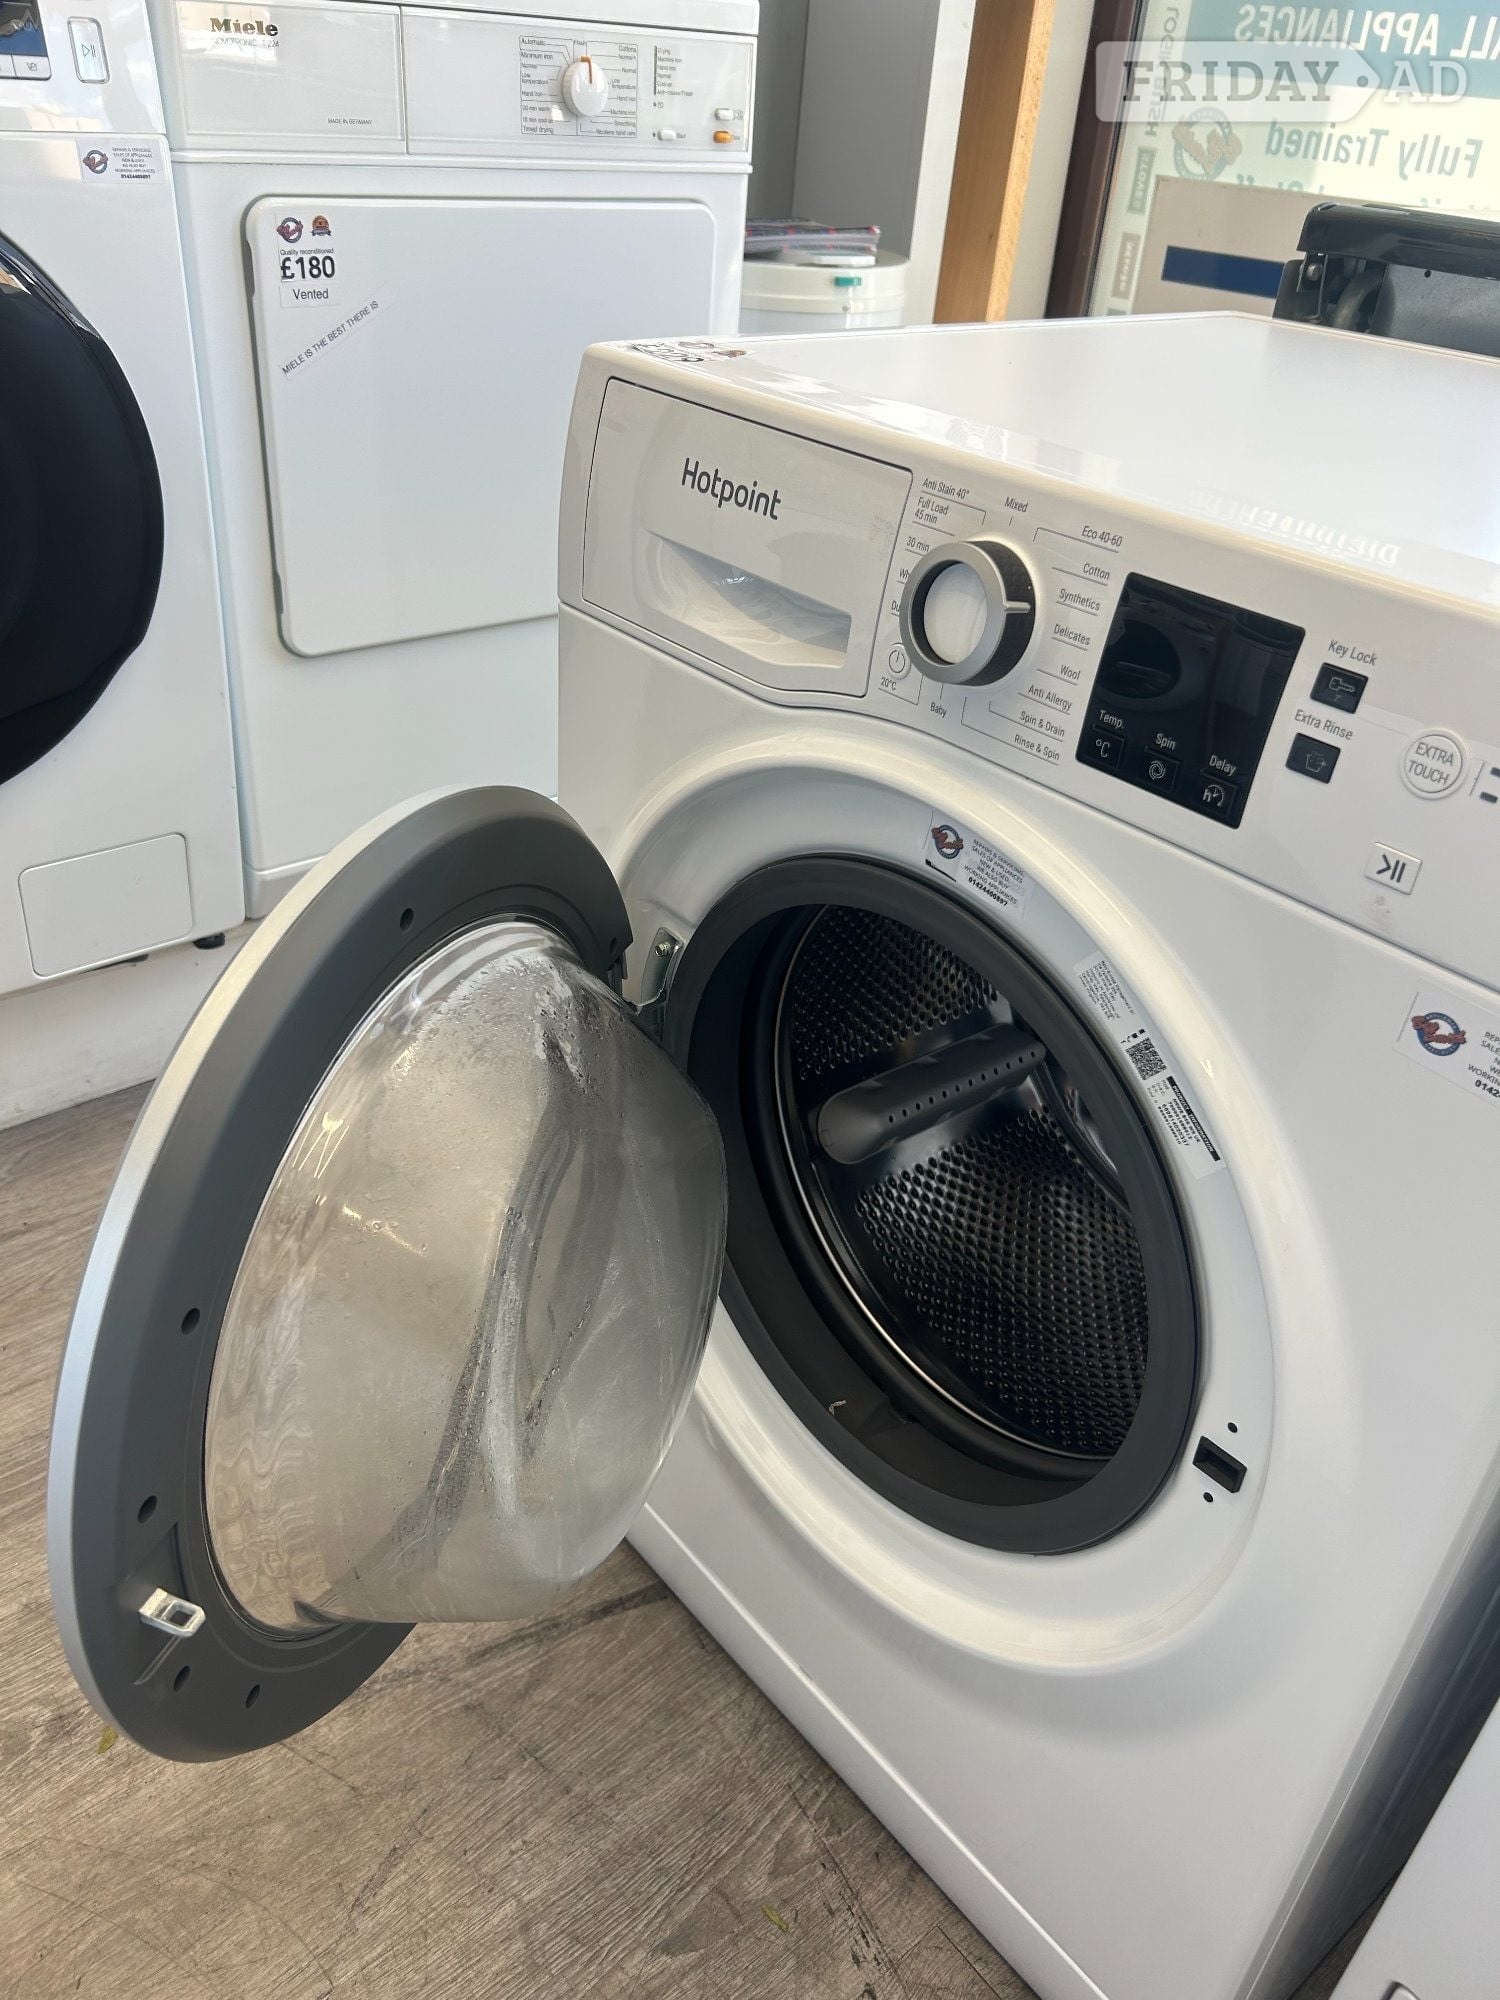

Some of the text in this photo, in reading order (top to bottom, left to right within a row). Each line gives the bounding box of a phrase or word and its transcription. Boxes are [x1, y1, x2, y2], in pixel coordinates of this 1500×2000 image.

[209, 18, 278, 36] Miele
[281, 256, 336, 280] £180
[293, 288, 329, 300] Vented
[282, 300, 379, 375] MIELE IS THE BEST THERE IS
[681, 457, 781, 520] Hotpoint
[922, 478, 936, 491] Anti
[938, 482, 956, 497] Stain
[917, 496, 949, 516] Full Load
[1005, 497, 1028, 513] Mixed
[914, 509, 938, 525] 45 min
[906, 536, 931, 552] 30 min
[1081, 525, 1123, 548] Eco 40-60
[1083, 562, 1111, 580] Cotton
[1058, 588, 1101, 612] Synthetics
[1053, 624, 1090, 646] Delicates
[1328, 639, 1377, 666] Key Lock
[1060, 664, 1080, 680] Wool
[1028, 684, 1072, 712] Anti Allergy
[930, 702, 947, 718] Baby
[1099, 710, 1124, 729] Temp.
[1020, 711, 1037, 727] Spin
[1045, 719, 1065, 737] Drain
[1295, 709, 1353, 740] Extra Rinse
[1014, 734, 1035, 752] Rinse
[1043, 745, 1060, 762] Spin
[1156, 733, 1176, 750] Spin
[1415, 742, 1454, 766] EXTRA
[1209, 755, 1236, 776] Delay
[1408, 760, 1450, 785] TOUCH
